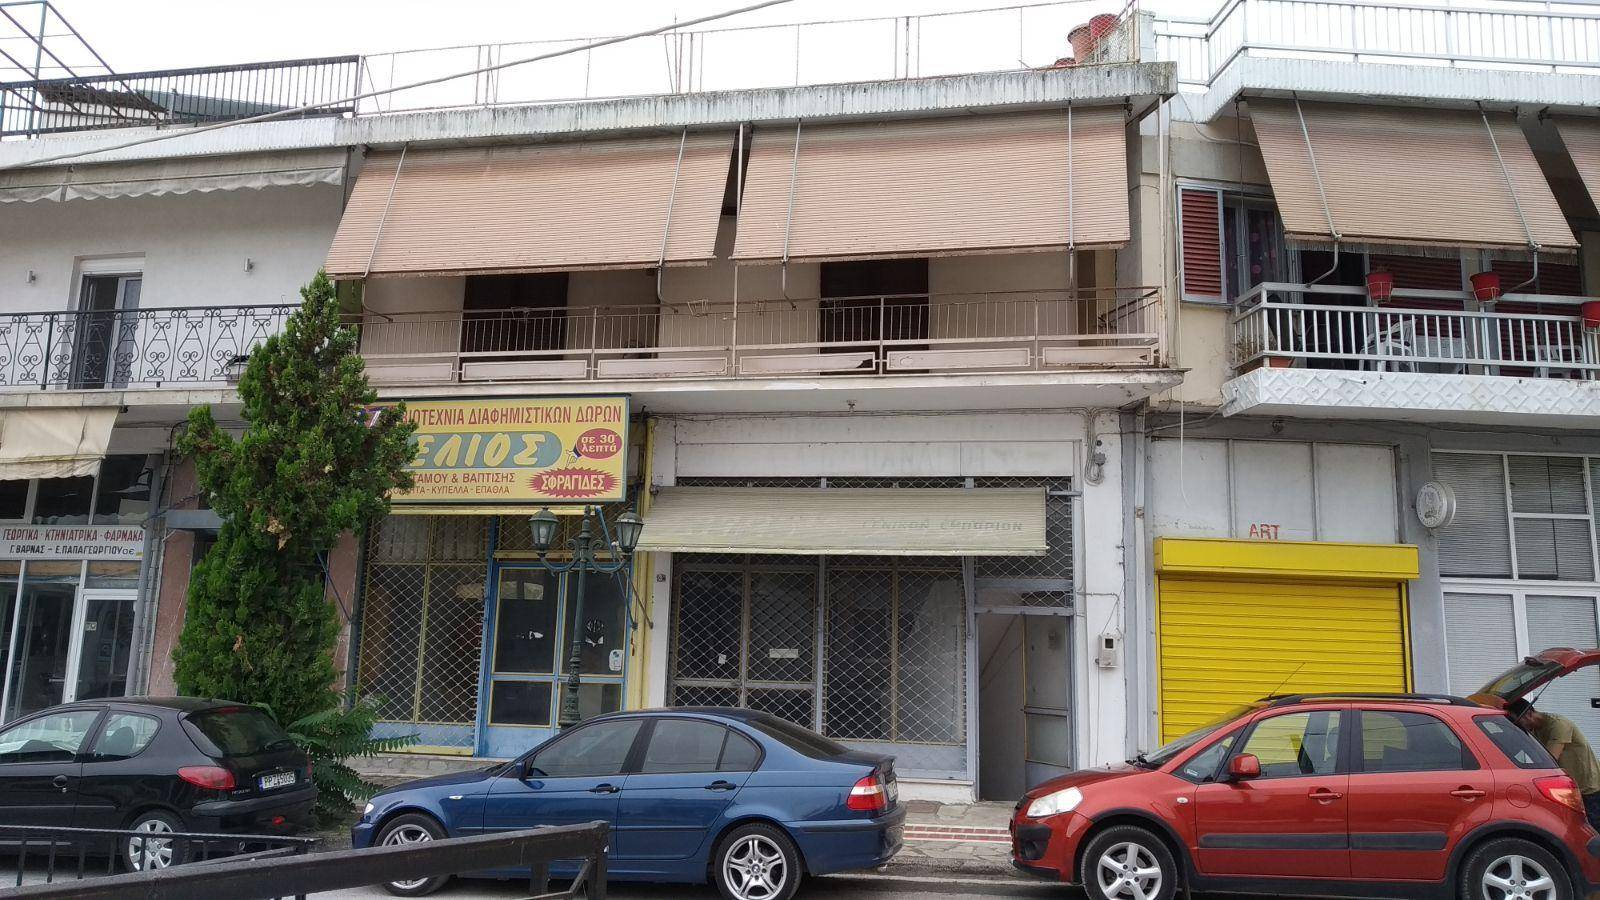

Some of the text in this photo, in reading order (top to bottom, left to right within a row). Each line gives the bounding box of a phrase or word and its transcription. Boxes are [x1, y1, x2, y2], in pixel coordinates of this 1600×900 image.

[468, 406, 572, 425] ΔΙΑΦΗΜΙΣΤΙΚΩΝ
[576, 405, 622, 423] ΔΩΡΩΝ
[581, 436, 596, 444] σε
[581, 444, 617, 453] λεπτά
[451, 473, 459, 484] &
[462, 472, 516, 483] ΒΑΠΤΙΣΗΣ
[541, 474, 605, 490] ΣΦΡΑΓΙΔΕΣ
[431, 485, 469, 494] ΚΥΠΕΛΛΑ
[475, 485, 510, 494] ΕΠΑΘΛΑ
[2, 529, 143, 542] ΓΕΩΡΓΙΚΑ ΚΤΗΝΙΑΤΡΙΚΑ ΦΑΡΜΑΚΑ
[1249, 523, 1280, 540] ART
